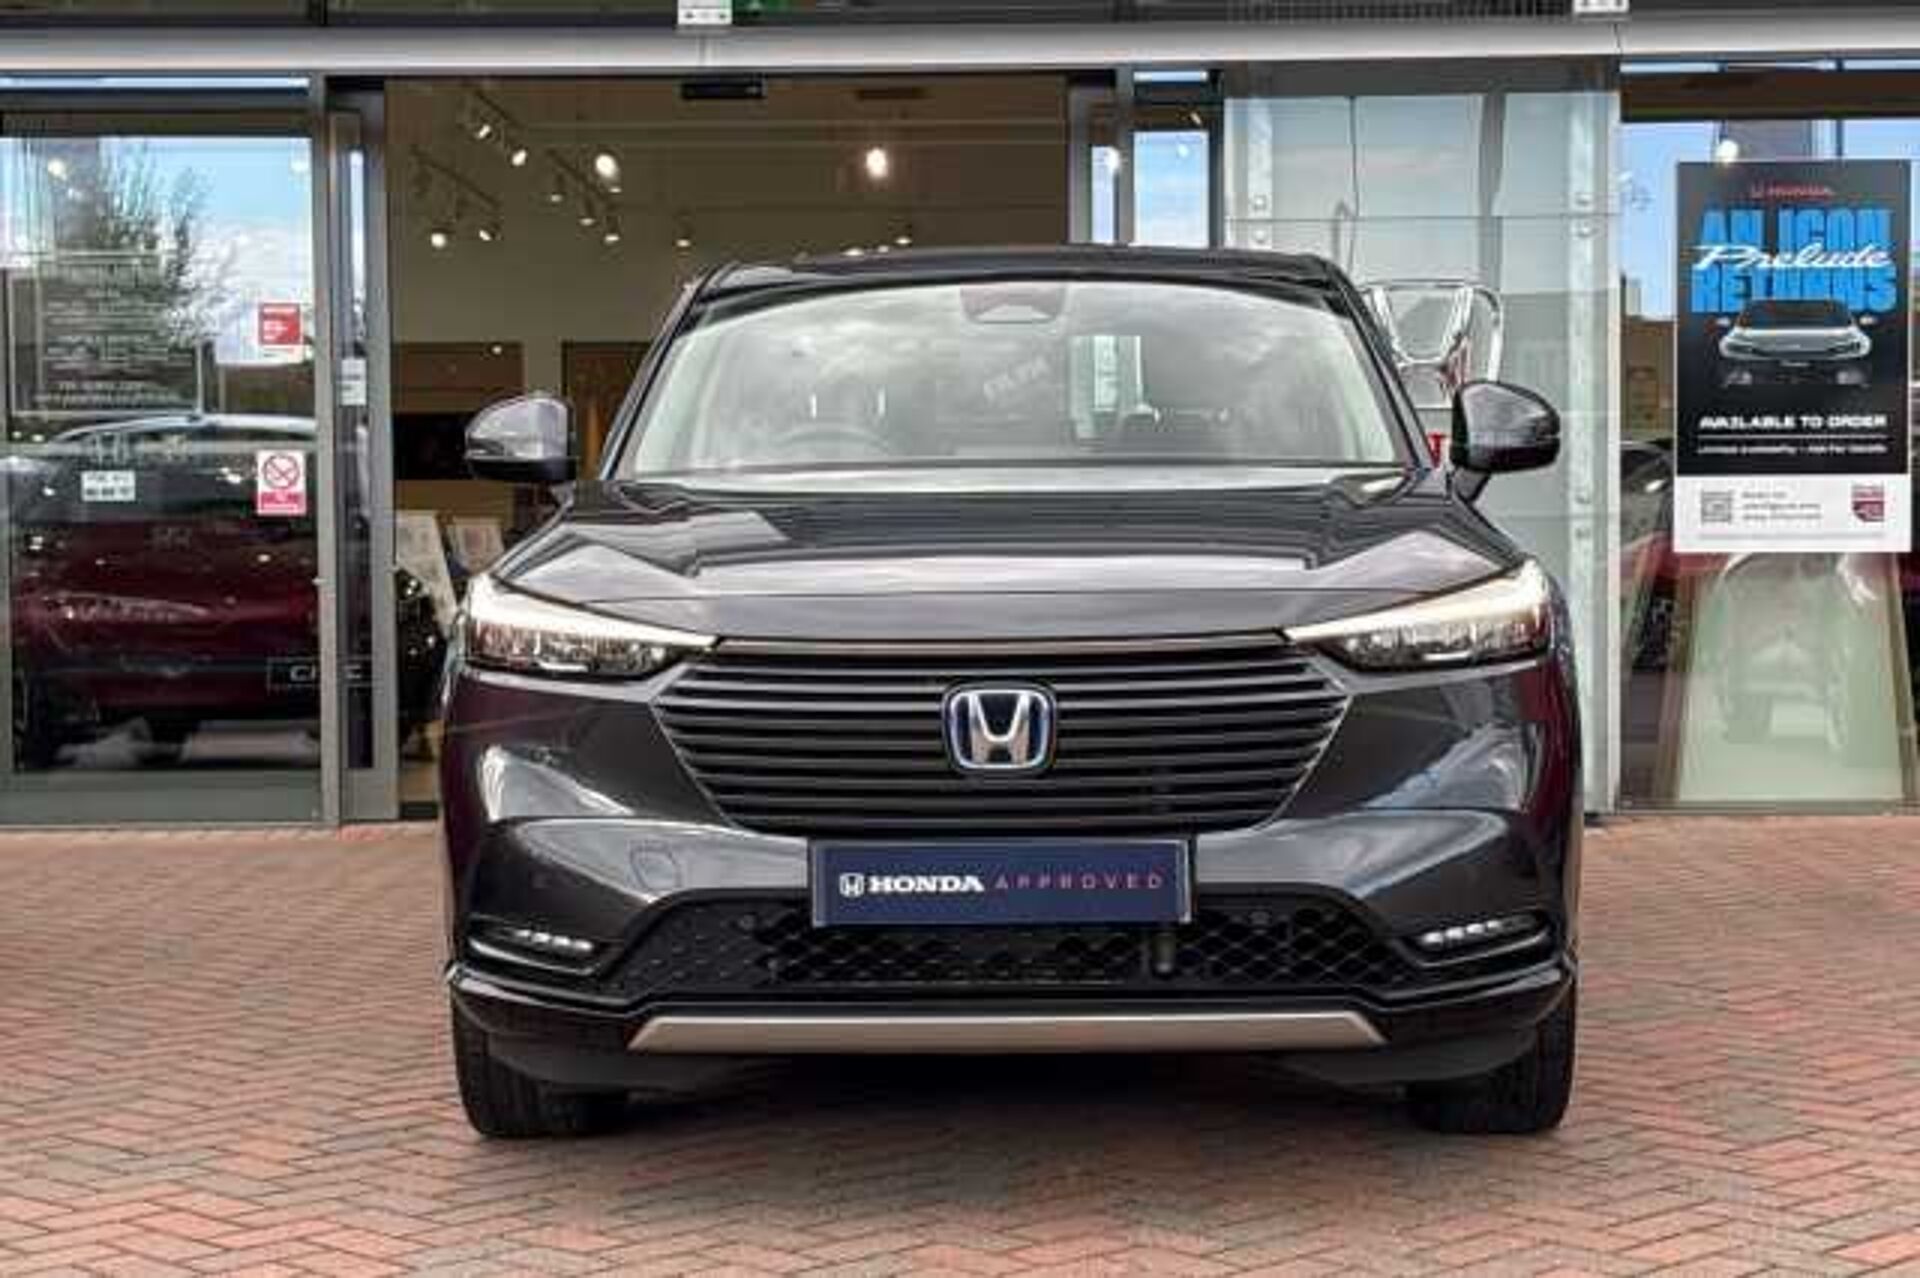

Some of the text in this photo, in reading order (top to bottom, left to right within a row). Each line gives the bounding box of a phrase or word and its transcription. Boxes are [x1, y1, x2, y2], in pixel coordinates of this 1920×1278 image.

[1692, 242, 1894, 270] Prelude
[1691, 264, 1897, 312] RETURNS
[1700, 414, 1887, 429] AVAILABLE TO ORDER
[868, 874, 985, 894] HONDA
[995, 875, 1163, 890] APPROVED
